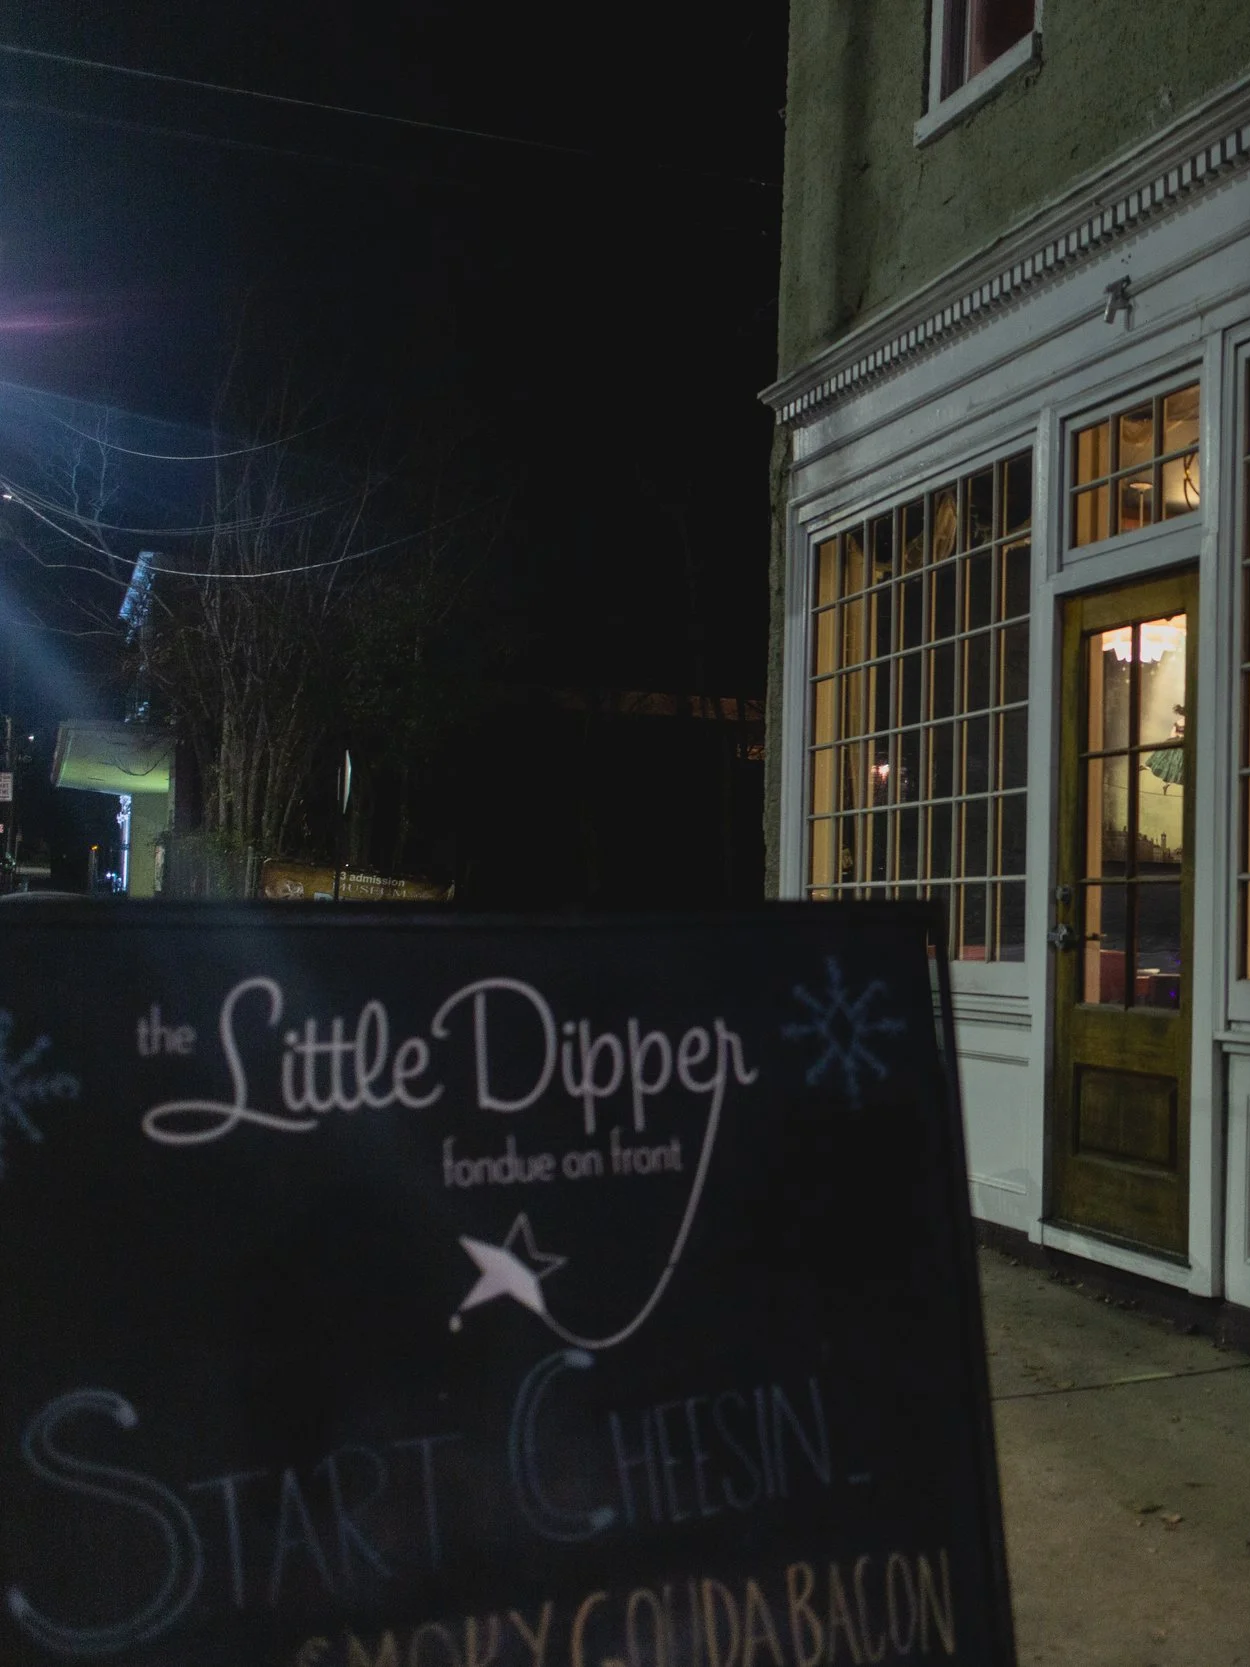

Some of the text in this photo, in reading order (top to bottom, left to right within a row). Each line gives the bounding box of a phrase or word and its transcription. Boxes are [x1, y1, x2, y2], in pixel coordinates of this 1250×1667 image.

[349, 872, 406, 888] admission
[136, 976, 759, 1146] the Little Dipper
[442, 1123, 683, 1188] fondue on front
[6, 1386, 466, 1656] START
[785, 1548, 957, 1667] BACON
